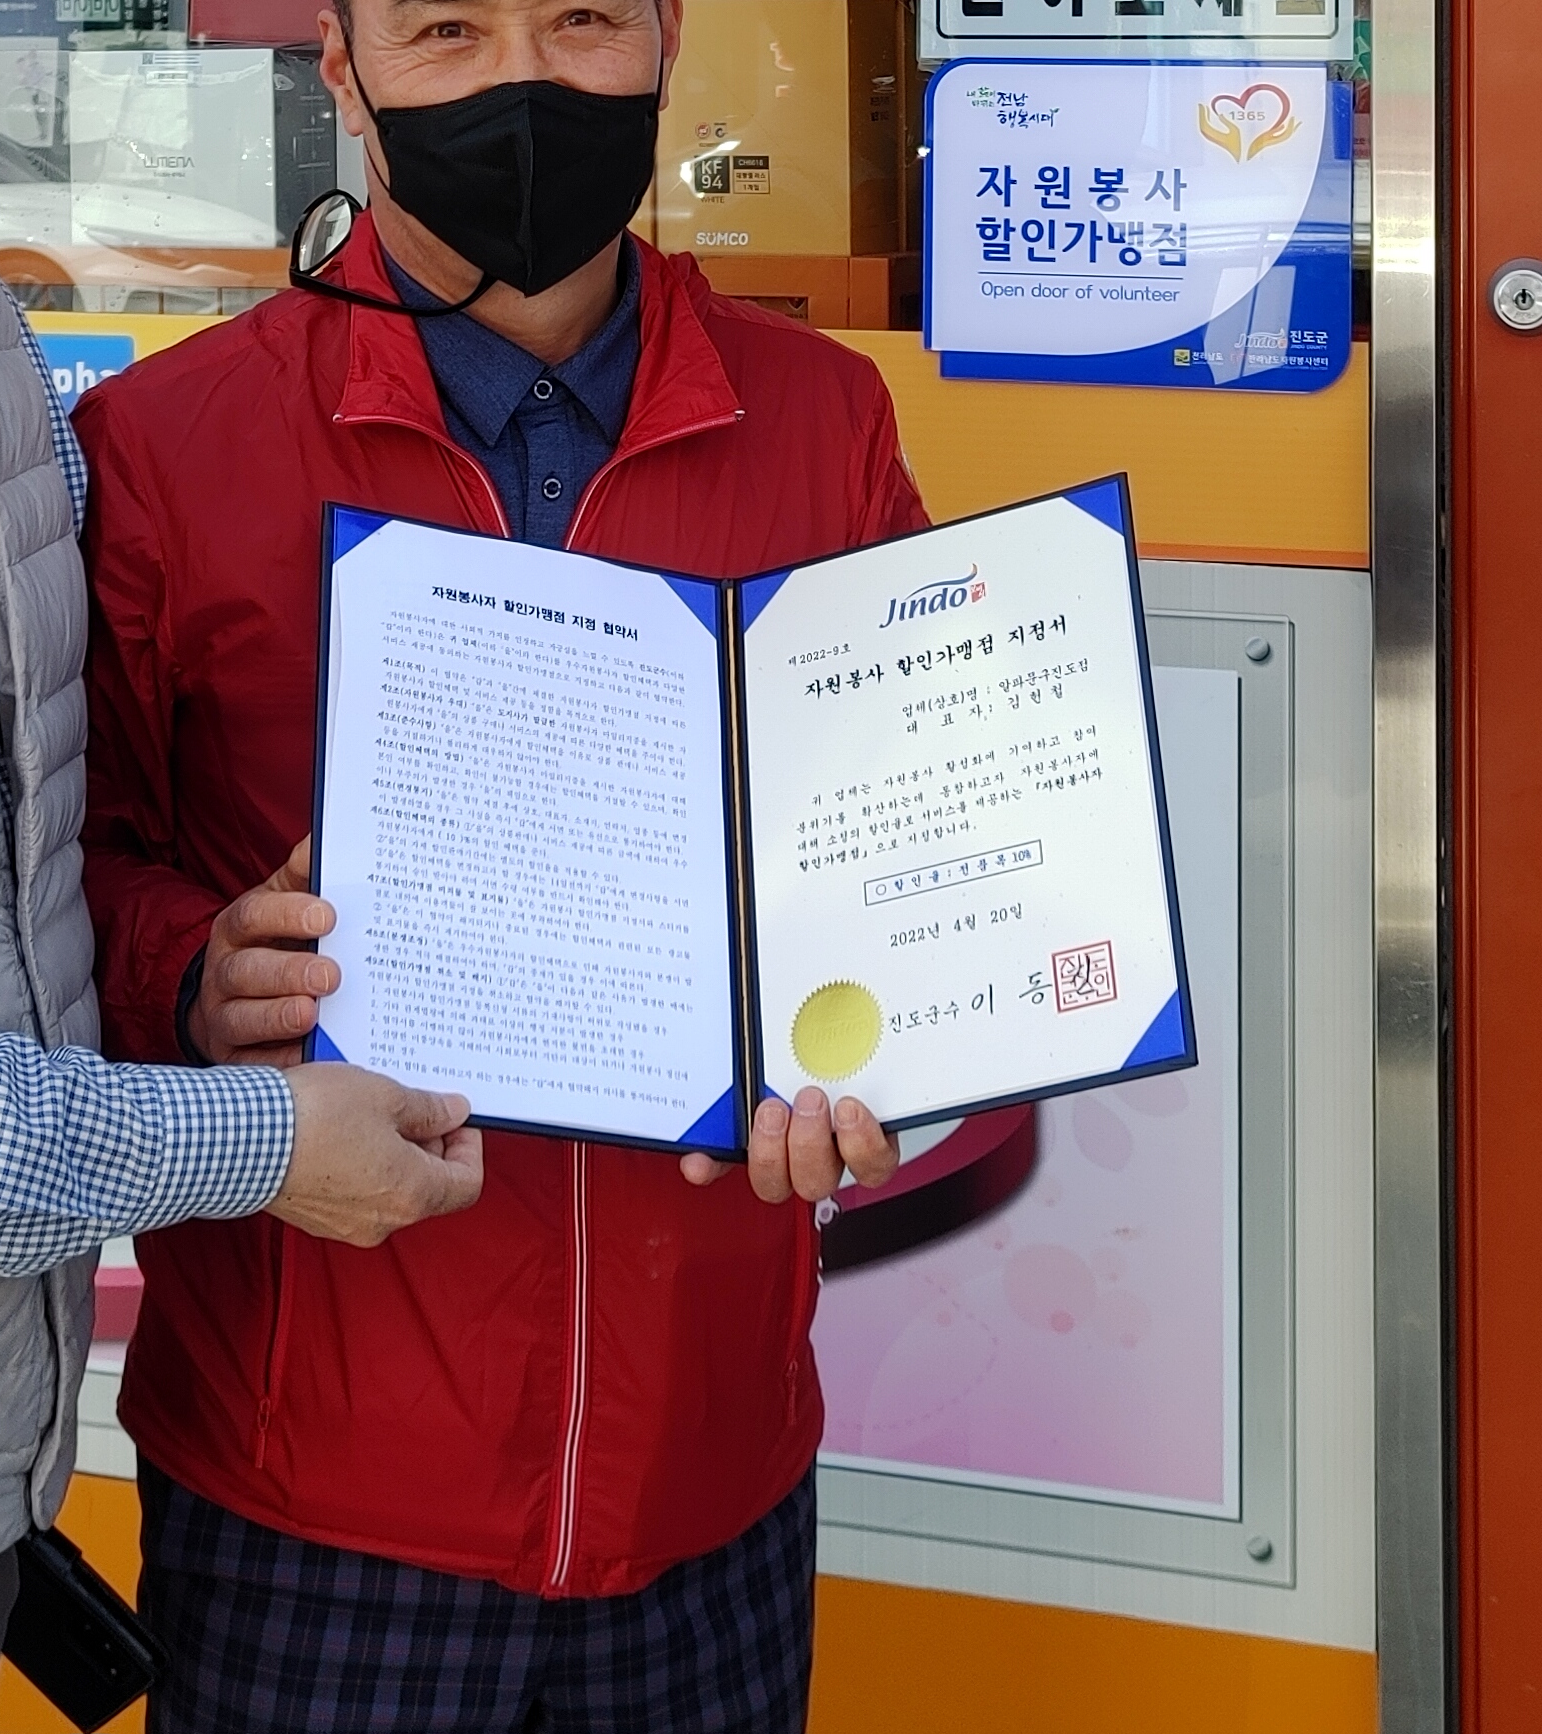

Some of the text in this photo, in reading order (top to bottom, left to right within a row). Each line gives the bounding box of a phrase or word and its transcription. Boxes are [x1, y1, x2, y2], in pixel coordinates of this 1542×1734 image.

[1229, 109, 1266, 123] 1365
[701, 159, 723, 175] KF
[701, 175, 723, 190] 94
[975, 164, 1187, 212] 자원봉사
[976, 215, 1187, 267] 할인가맹점
[981, 281, 1181, 303] Open door of volunteer
[1289, 329, 1329, 345] 진도군
[432, 586, 638, 641] 자원봉사자 할인가맹점 지정 협약서
[879, 578, 967, 628] Jindo
[805, 614, 1066, 699] 자원봉사 할인가맹점 지정서
[890, 922, 939, 947] 2022년
